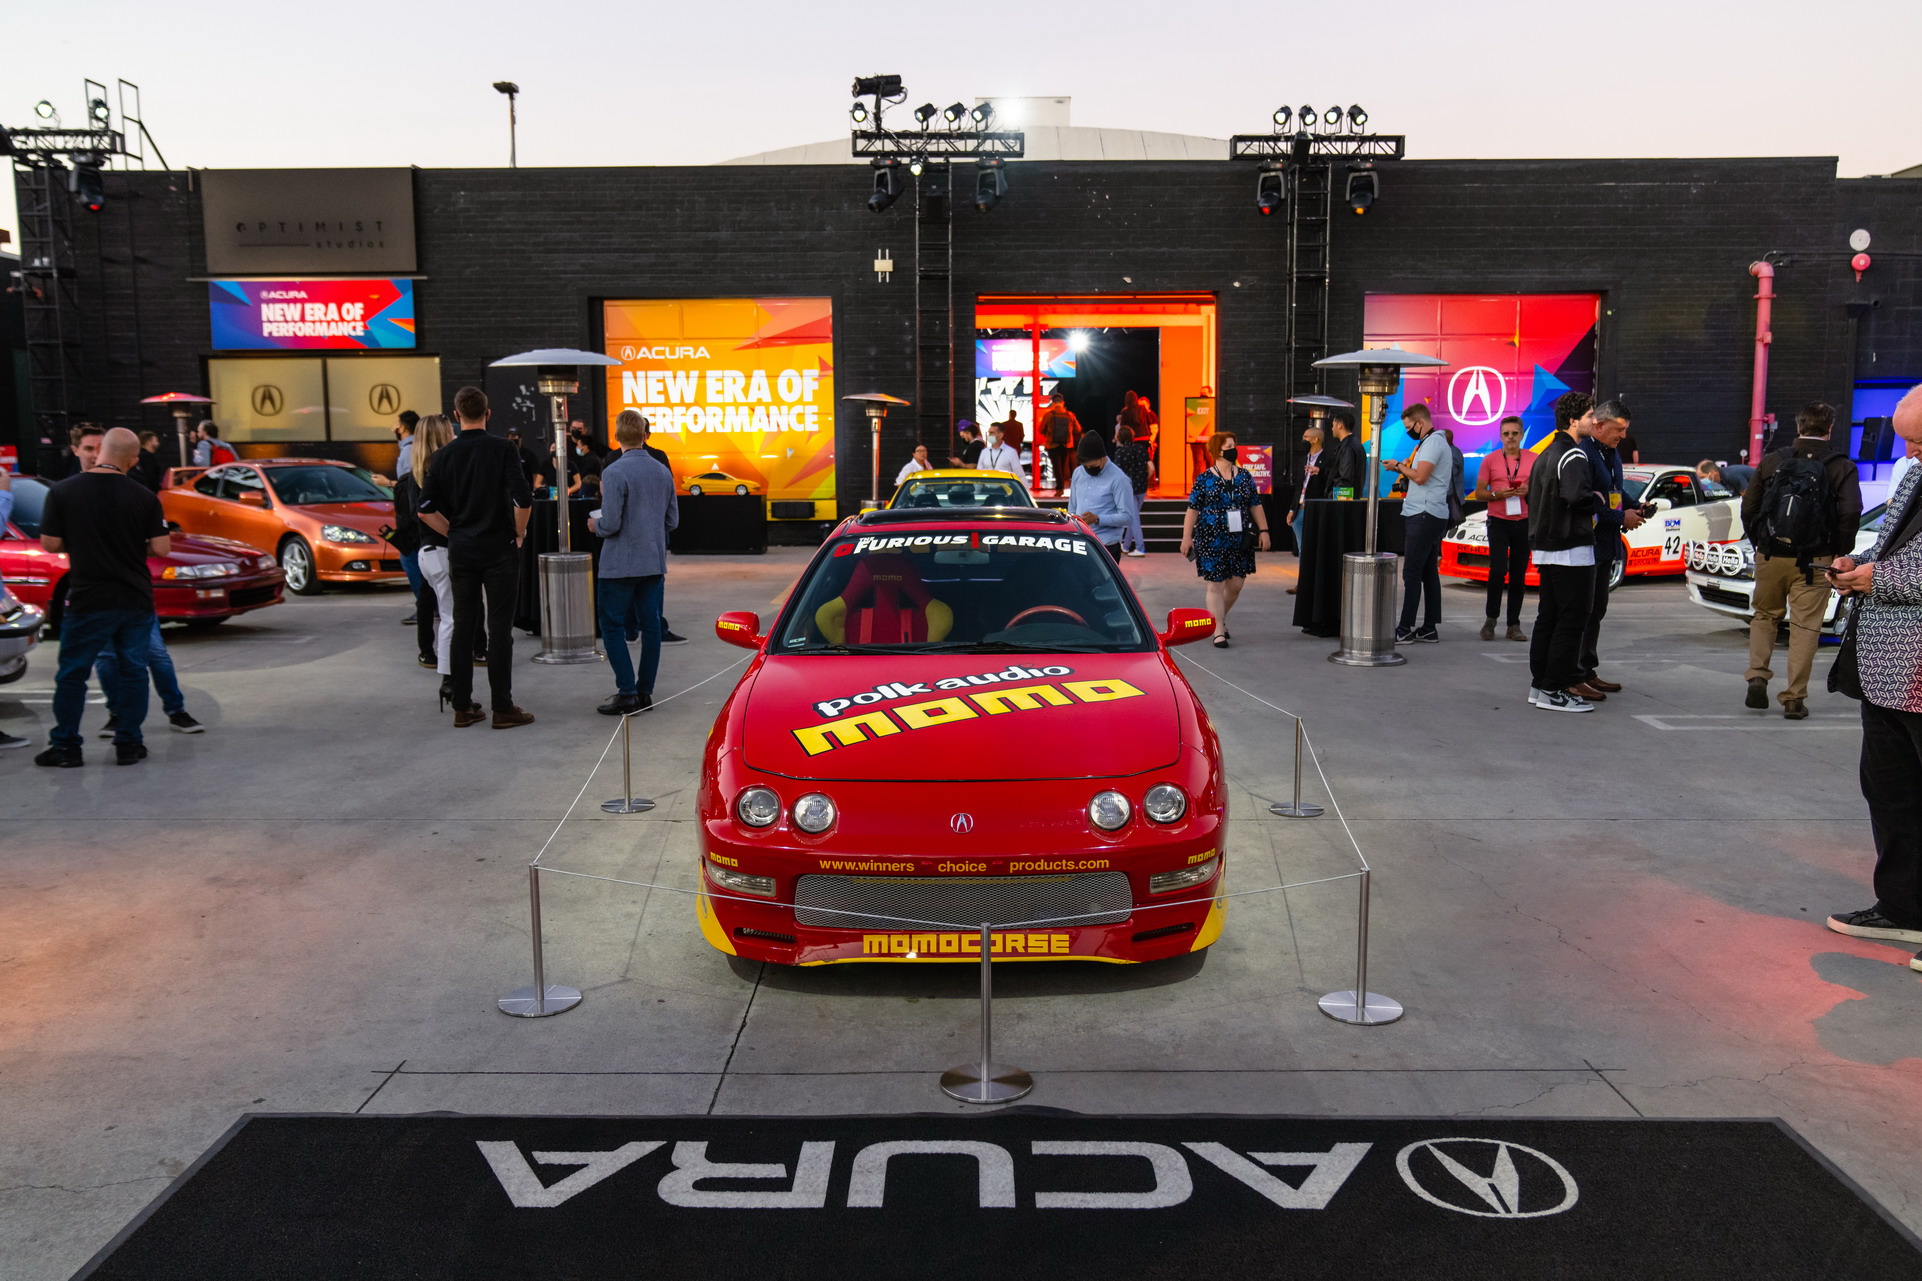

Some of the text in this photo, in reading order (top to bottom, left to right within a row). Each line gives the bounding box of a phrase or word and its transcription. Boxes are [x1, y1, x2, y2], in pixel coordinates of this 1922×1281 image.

[267, 290, 308, 299] ACURA
[261, 302, 365, 322] NEW ERA OF
[262, 321, 365, 337] PERFORMANCE
[636, 346, 711, 360] ACURA
[622, 368, 819, 404] NEW ERA OF
[853, 535, 969, 554] FURIOUS
[981, 535, 1088, 556] GARAGE
[1630, 548, 1661, 558] ACURA
[1664, 535, 1681, 556] 42
[814, 664, 1074, 718] polk audio
[819, 858, 1110, 873] www.winners choice products.com
[476, 1139, 1374, 1209] ACURA
